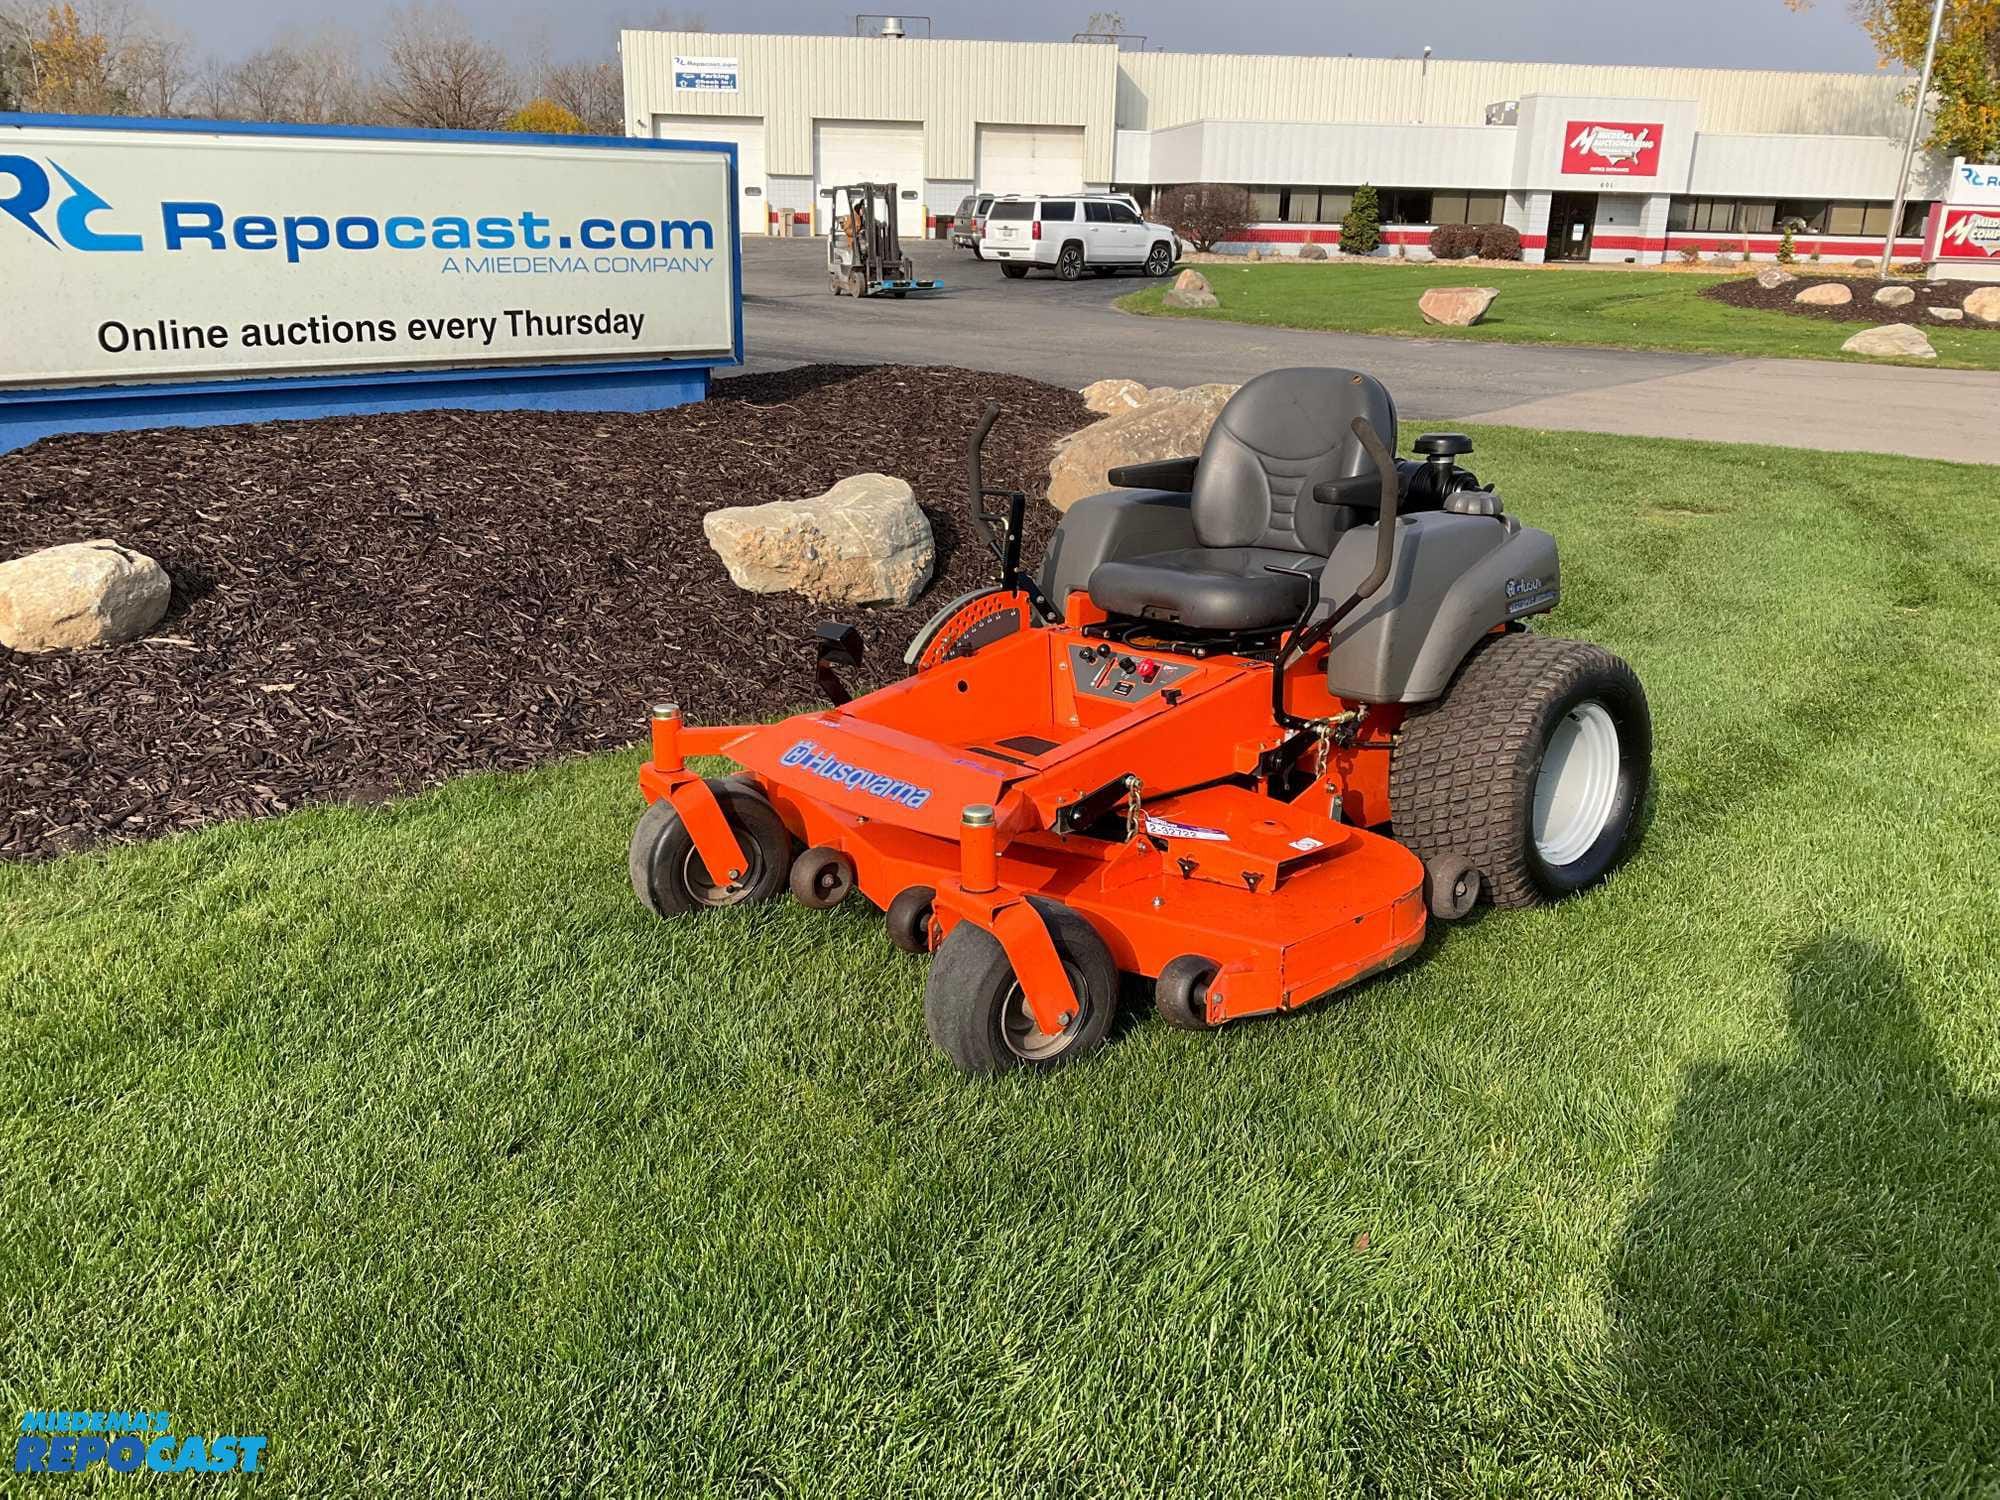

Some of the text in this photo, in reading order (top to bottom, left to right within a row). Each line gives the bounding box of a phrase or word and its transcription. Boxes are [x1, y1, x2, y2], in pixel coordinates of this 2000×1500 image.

[160, 201, 714, 263] Repocast.com
[441, 256, 714, 274] A MIEDEMA COMPANY
[98, 307, 645, 353] Online auctions every Thursday
[801, 750, 932, 809] Husqvarna
